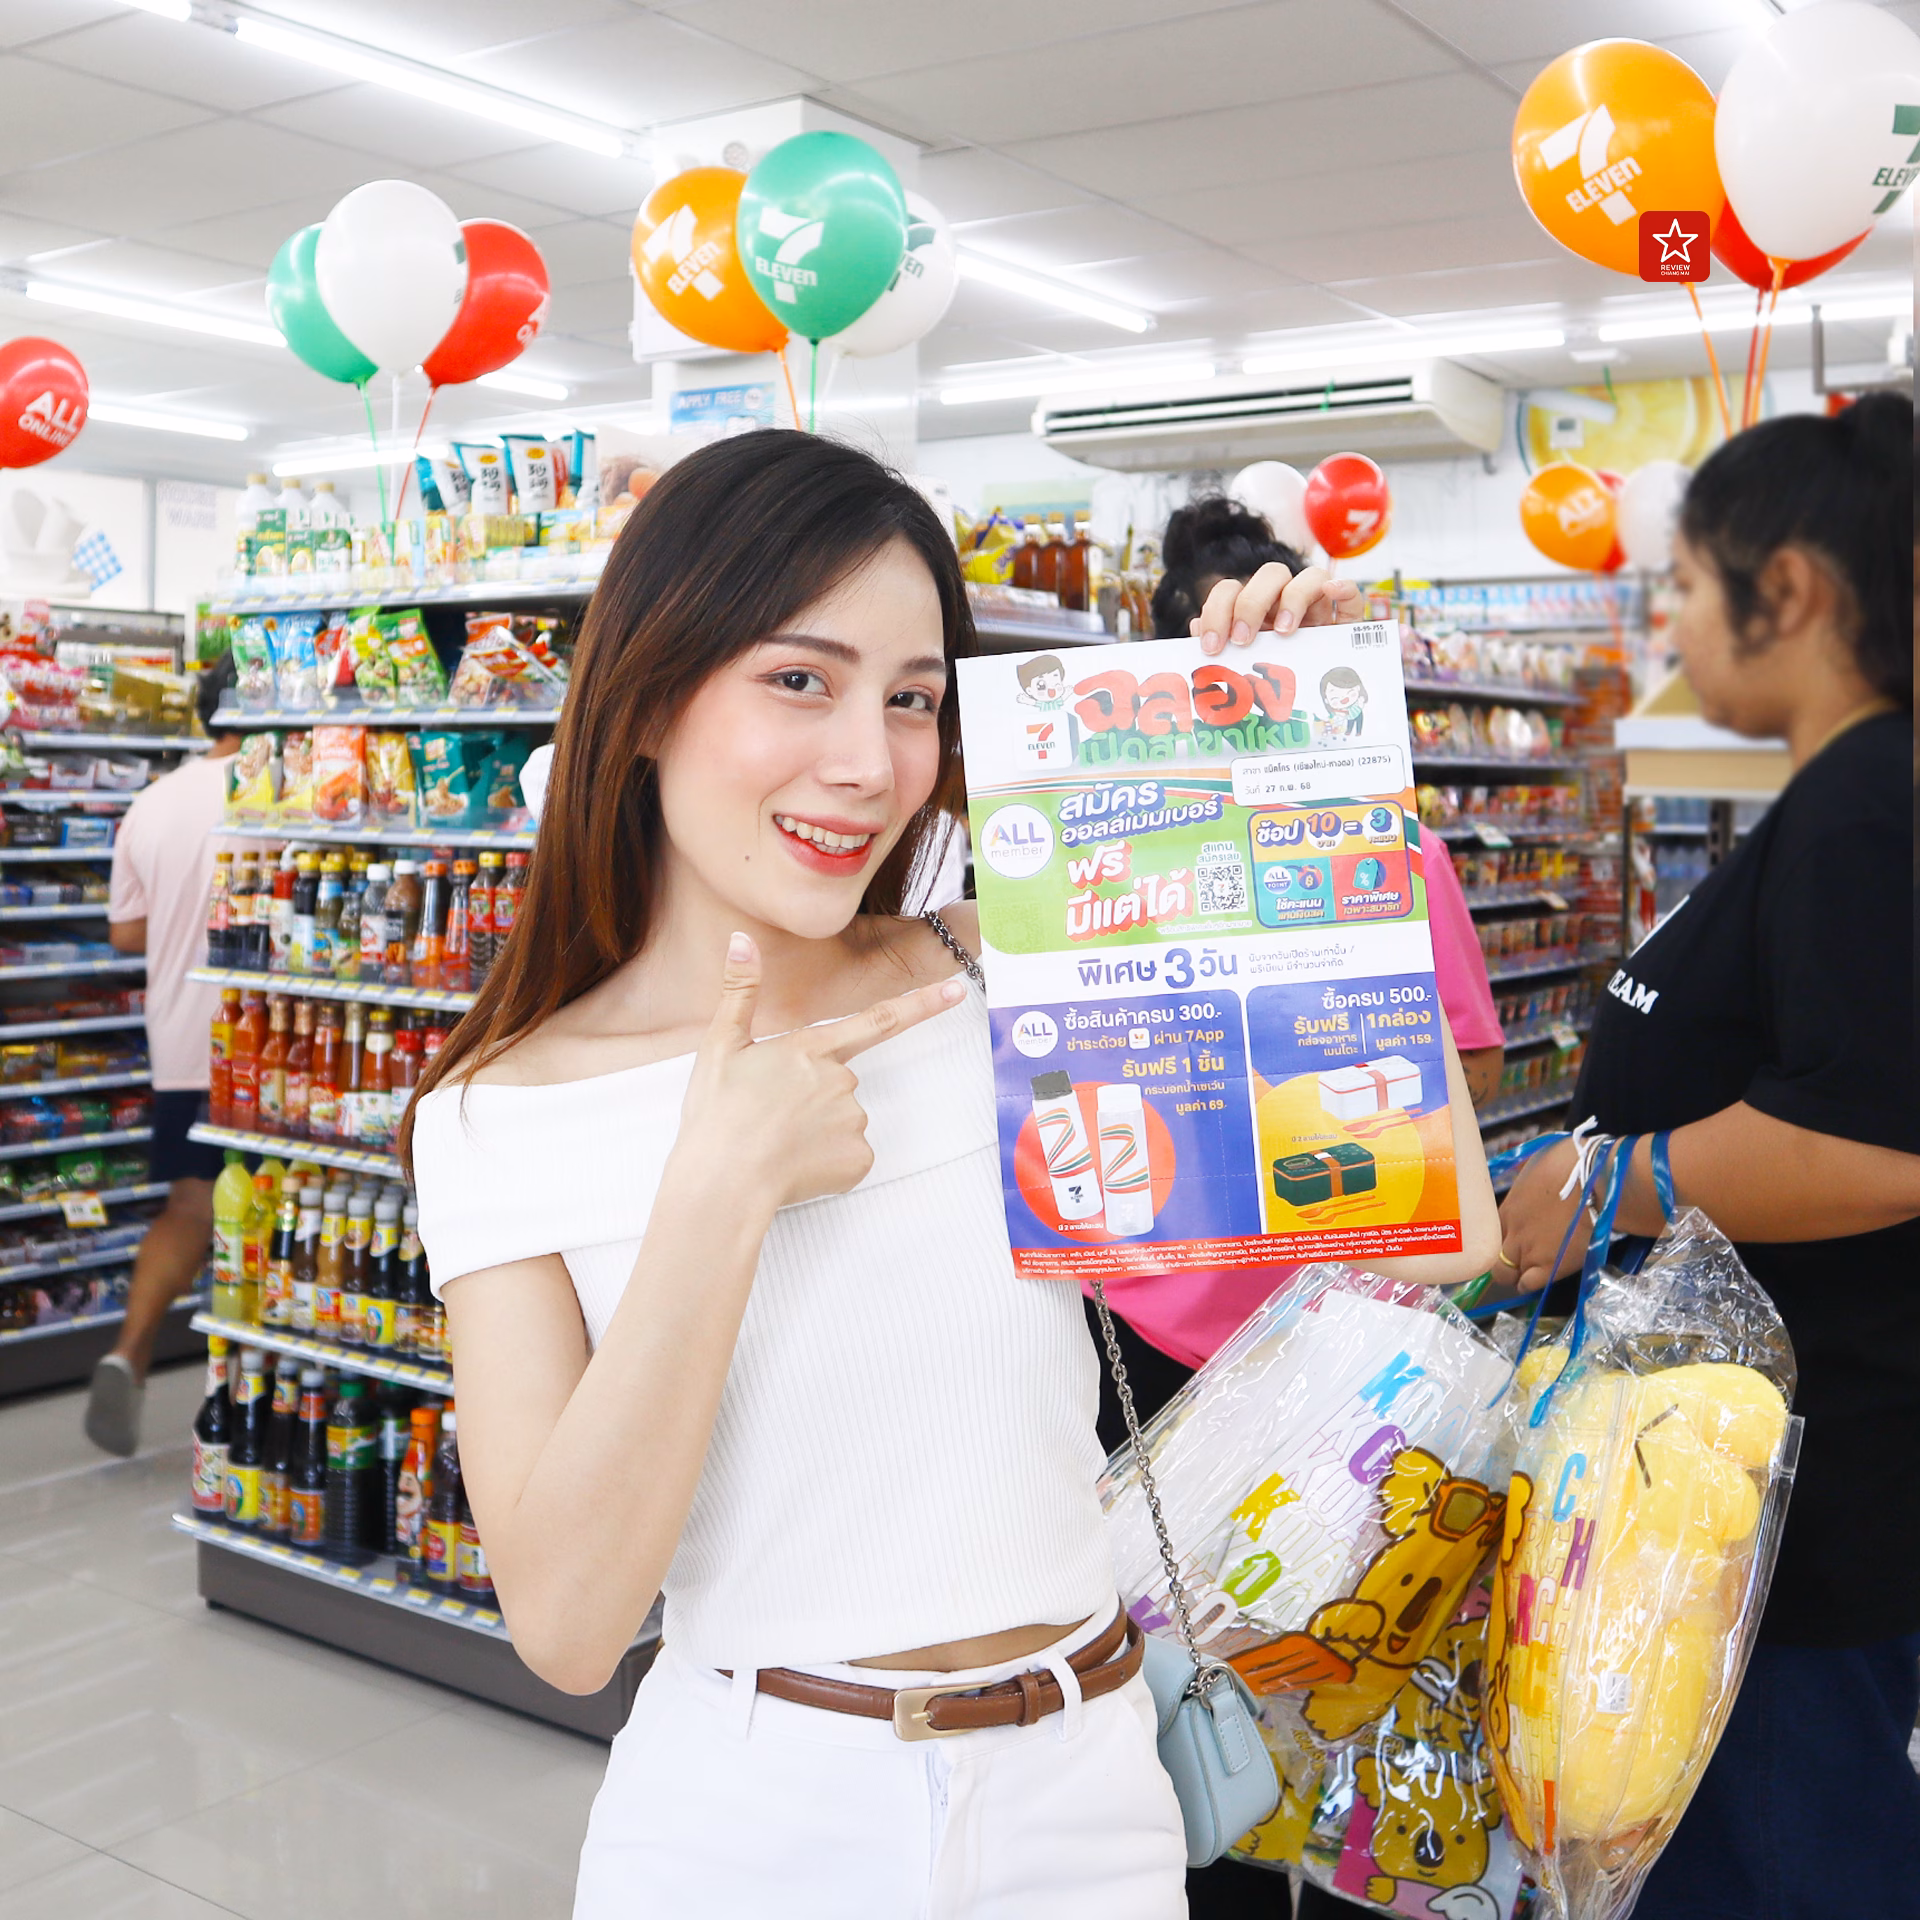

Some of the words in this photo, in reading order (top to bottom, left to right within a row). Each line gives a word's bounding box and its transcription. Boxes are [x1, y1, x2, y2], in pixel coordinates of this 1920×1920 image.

[25, 390, 82, 434] ALL
[1073, 662, 1297, 735] ฉลอง
[1077, 709, 1312, 768] เปิดสาขาใหม่
[1265, 785, 1277, 794] 27
[1059, 781, 1162, 824] สมัคร
[1060, 793, 1221, 845] ออลล์เมมเบอร์
[1256, 819, 1304, 846] ช้อป
[1306, 812, 1341, 838] 10
[1370, 807, 1392, 832] 3
[990, 821, 1046, 847] ALL
[990, 846, 1044, 860] member
[1197, 851, 1241, 864] สมัครเลย
[1202, 841, 1234, 854] สแกน
[1066, 840, 1130, 887] ฟรี
[1066, 868, 1192, 939] มีแต่ได้
[1275, 897, 1325, 911] ใช้คะแนน
[1341, 890, 1401, 906] ราคาพิเศษ
[1343, 902, 1401, 915] เฉพาะสมาชิก
[1077, 958, 1158, 987] พิเศษ
[1163, 947, 1196, 989] 3
[1199, 948, 1238, 977] วัน
[1321, 986, 1385, 1010] ซื้อครบ
[1389, 985, 1432, 1002] 500.-
[1063, 1006, 1175, 1031] ซื้อสินค้าครบ
[1178, 1002, 1223, 1021] 300.-
[1293, 1012, 1350, 1035] รับฟรี
[1017, 1022, 1053, 1038] ALL
[1066, 1035, 1127, 1052] ชำระด้วย
[1154, 1029, 1182, 1046] ผ่าน
[1297, 1033, 1358, 1047] กล่องอาหาร
[1323, 1043, 1359, 1057] เบนโตะ
[1375, 1034, 1407, 1051] มูลค่า
[1121, 1055, 1178, 1078] รับฟรี
[1182, 1057, 1192, 1073] 1
[1197, 1049, 1225, 1072] ชิ้น
[1144, 1079, 1226, 1096] กระบอกน้ำเซเว่น
[1175, 1100, 1207, 1116] มูลค่า
